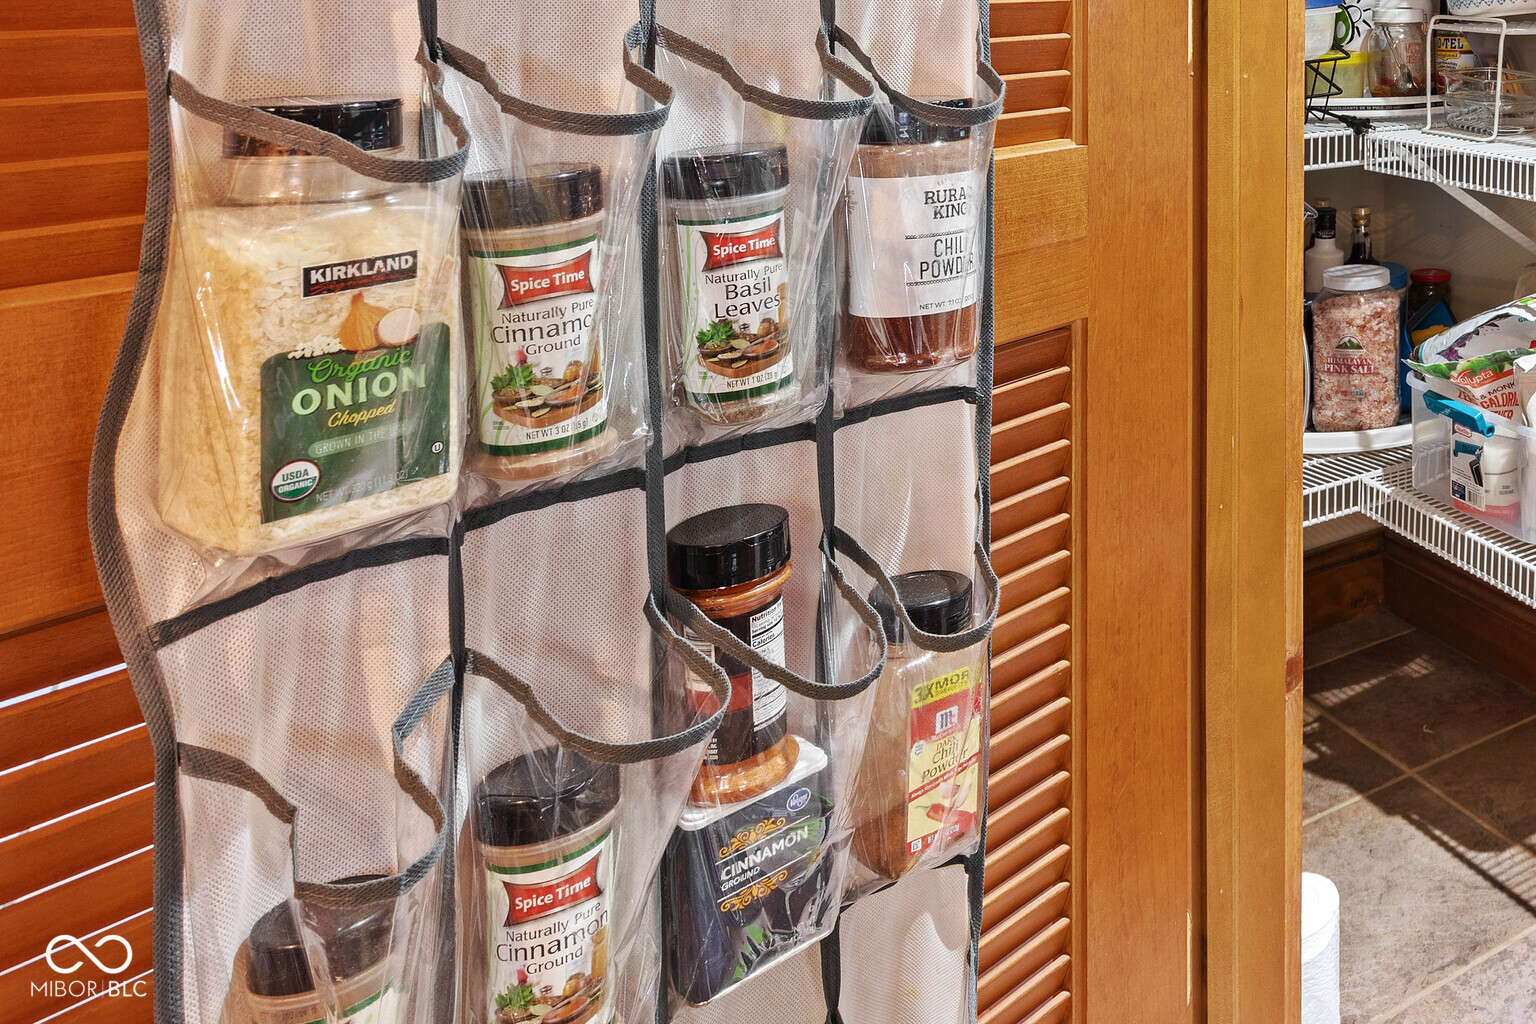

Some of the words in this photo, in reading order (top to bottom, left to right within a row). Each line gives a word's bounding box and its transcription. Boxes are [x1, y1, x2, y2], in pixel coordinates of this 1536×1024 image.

[924, 186, 967, 205] RURA
[713, 242, 747, 258] Spice
[748, 236, 776, 252] Time
[934, 236, 964, 258] CHIL
[310, 255, 414, 284] KIRKLAND
[705, 269, 760, 284] Naturally
[764, 262, 783, 276] Pure
[920, 253, 974, 280] POWDR
[511, 277, 550, 295] Spice
[553, 269, 585, 286] Time
[725, 277, 771, 301] Basil
[501, 306, 567, 324] Naturally
[572, 298, 594, 313] Pure
[714, 293, 780, 319] Leaves
[920, 302, 934, 311] NET
[492, 314, 592, 344] Cinnamo
[525, 335, 581, 356] Ground
[308, 348, 412, 384] Organic
[1324, 364, 1349, 373] PINK
[1350, 364, 1374, 374] SALT
[1327, 357, 1373, 365] HIMALAYAN
[291, 364, 427, 415] ONION
[726, 379, 739, 389] NET
[740, 377, 750, 387] WT
[756, 373, 764, 383] OZ
[327, 399, 397, 428] Chopped
[315, 437, 351, 455] GROWN
[354, 434, 365, 445] IN
[369, 429, 387, 443] THE
[526, 430, 539, 440] NET
[540, 428, 553, 439] WT
[561, 424, 570, 435] OZ
[277, 478, 314, 494] ORGANIC
[282, 466, 310, 483] USDA
[751, 607, 777, 623] Nutrition
[752, 633, 776, 648] Calories
[914, 682, 934, 706] 3X
[932, 742, 959, 764] Chili
[720, 825, 809, 881] CINNAMON
[721, 866, 761, 892] GROUND
[515, 894, 554, 912] Spice
[556, 877, 591, 900] Time
[506, 919, 569, 942] Naturally
[574, 902, 601, 925] Pure
[496, 910, 608, 962] Cinnamon
[526, 946, 583, 974] Ground
